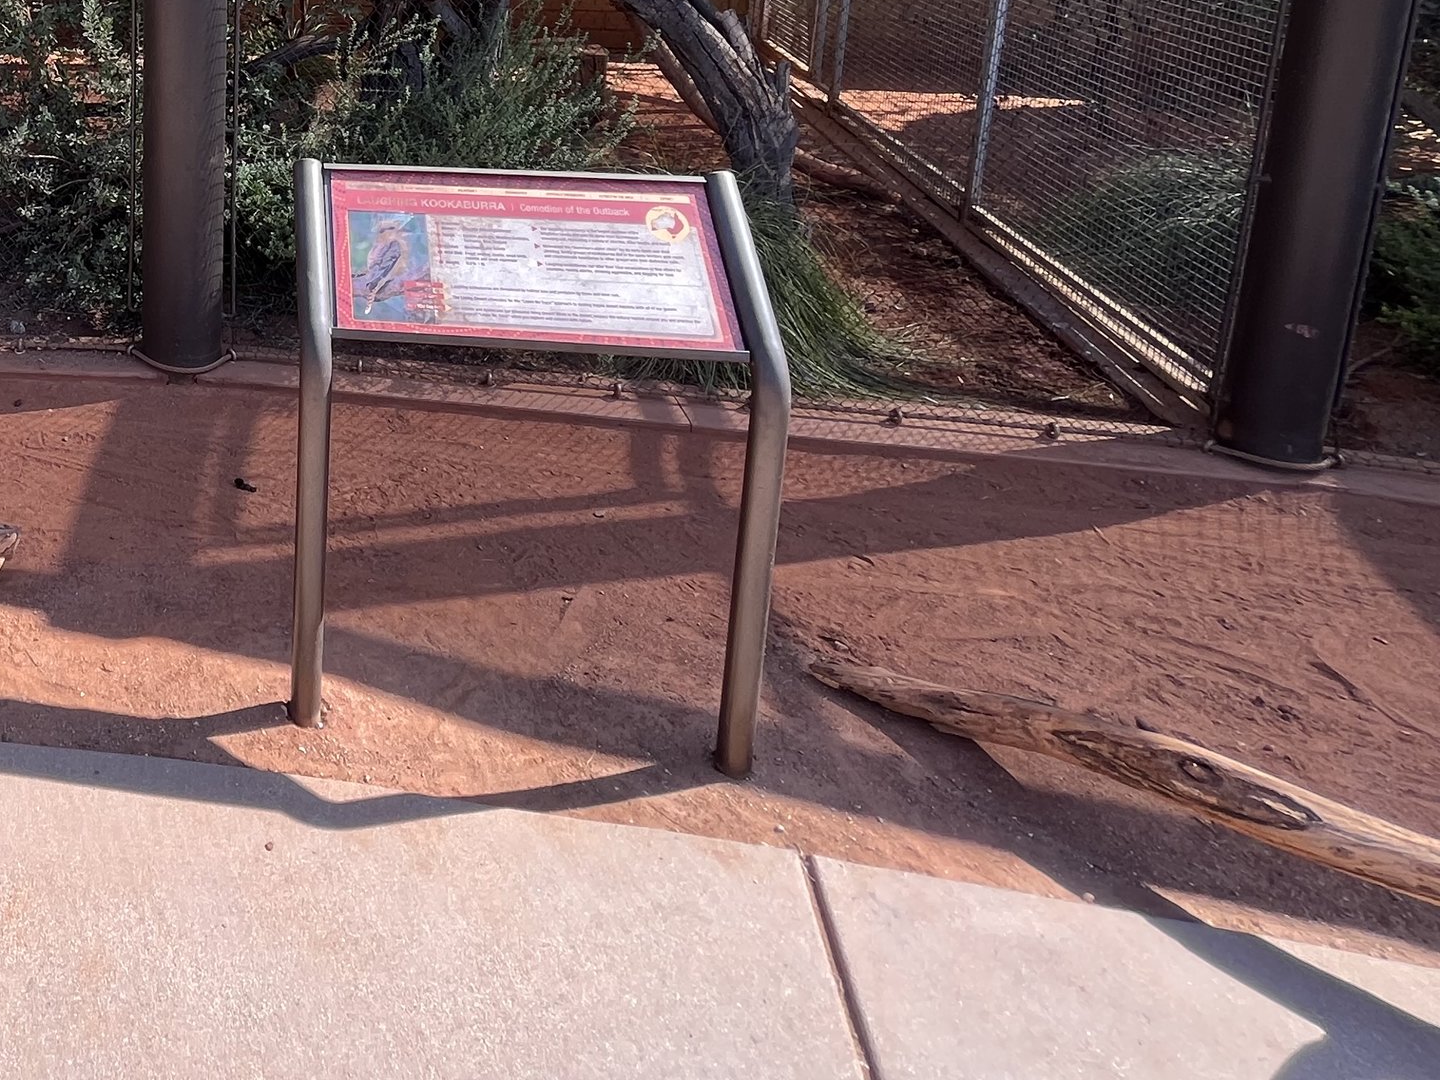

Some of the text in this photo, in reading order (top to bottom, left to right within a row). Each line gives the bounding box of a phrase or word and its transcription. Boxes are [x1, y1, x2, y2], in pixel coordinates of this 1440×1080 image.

[421, 198, 506, 211] KOOKABURRA
[520, 203, 561, 213] Comedian
[565, 205, 574, 214] of
[576, 206, 591, 215] the
[593, 207, 630, 216] Outback
